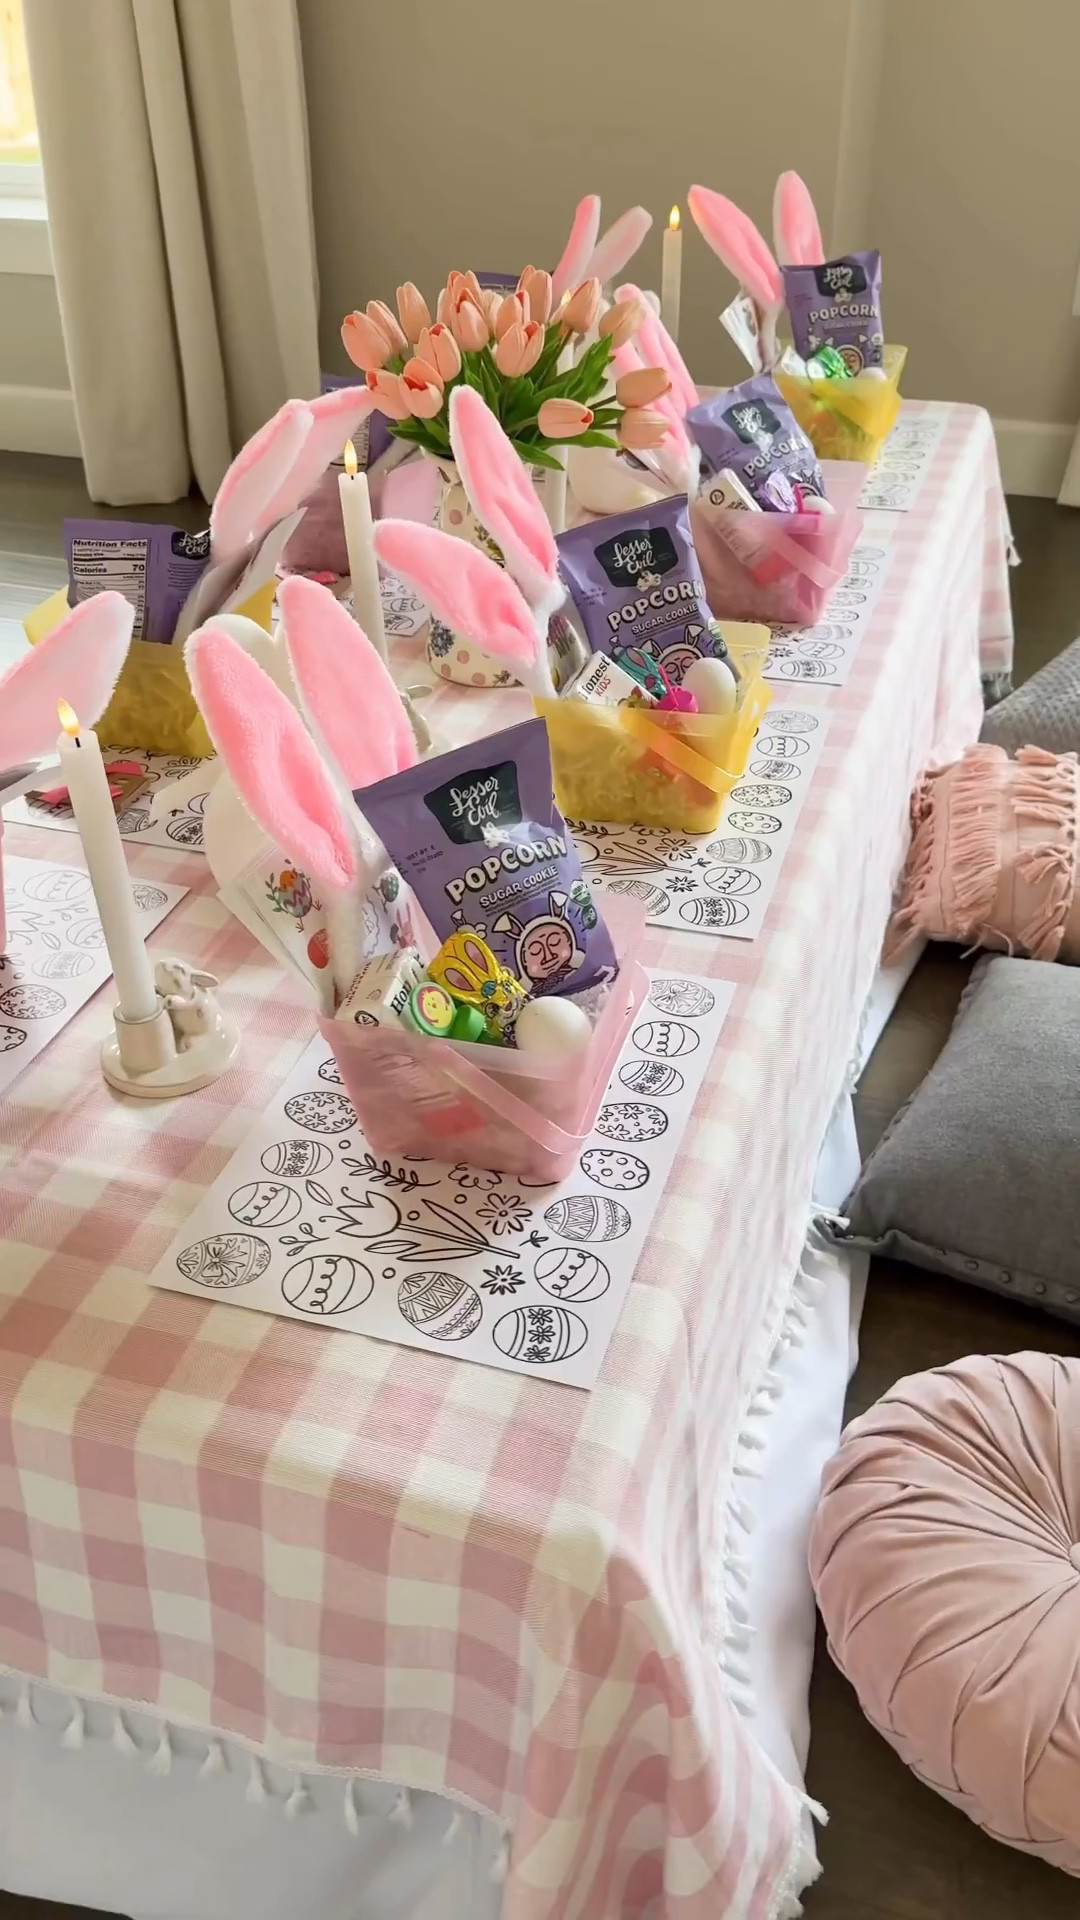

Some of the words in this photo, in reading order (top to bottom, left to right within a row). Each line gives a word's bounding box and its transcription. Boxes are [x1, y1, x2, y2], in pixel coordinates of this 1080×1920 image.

[808, 304, 879, 325] POPCORN
[73, 539, 117, 548] Nutrition
[612, 537, 653, 568] Lesser
[132, 564, 145, 572] 70
[627, 551, 655, 574] Evil
[607, 580, 704, 632] POPCORN
[632, 617, 664, 635] SUGAR
[665, 602, 699, 622] COOKIE
[595, 674, 612, 697] KIDS
[449, 776, 500, 817] Lesser
[467, 792, 501, 826] Evil
[445, 836, 568, 906] POPCORN
[479, 883, 522, 909] SUGAR
[522, 865, 558, 889] COOKIE
